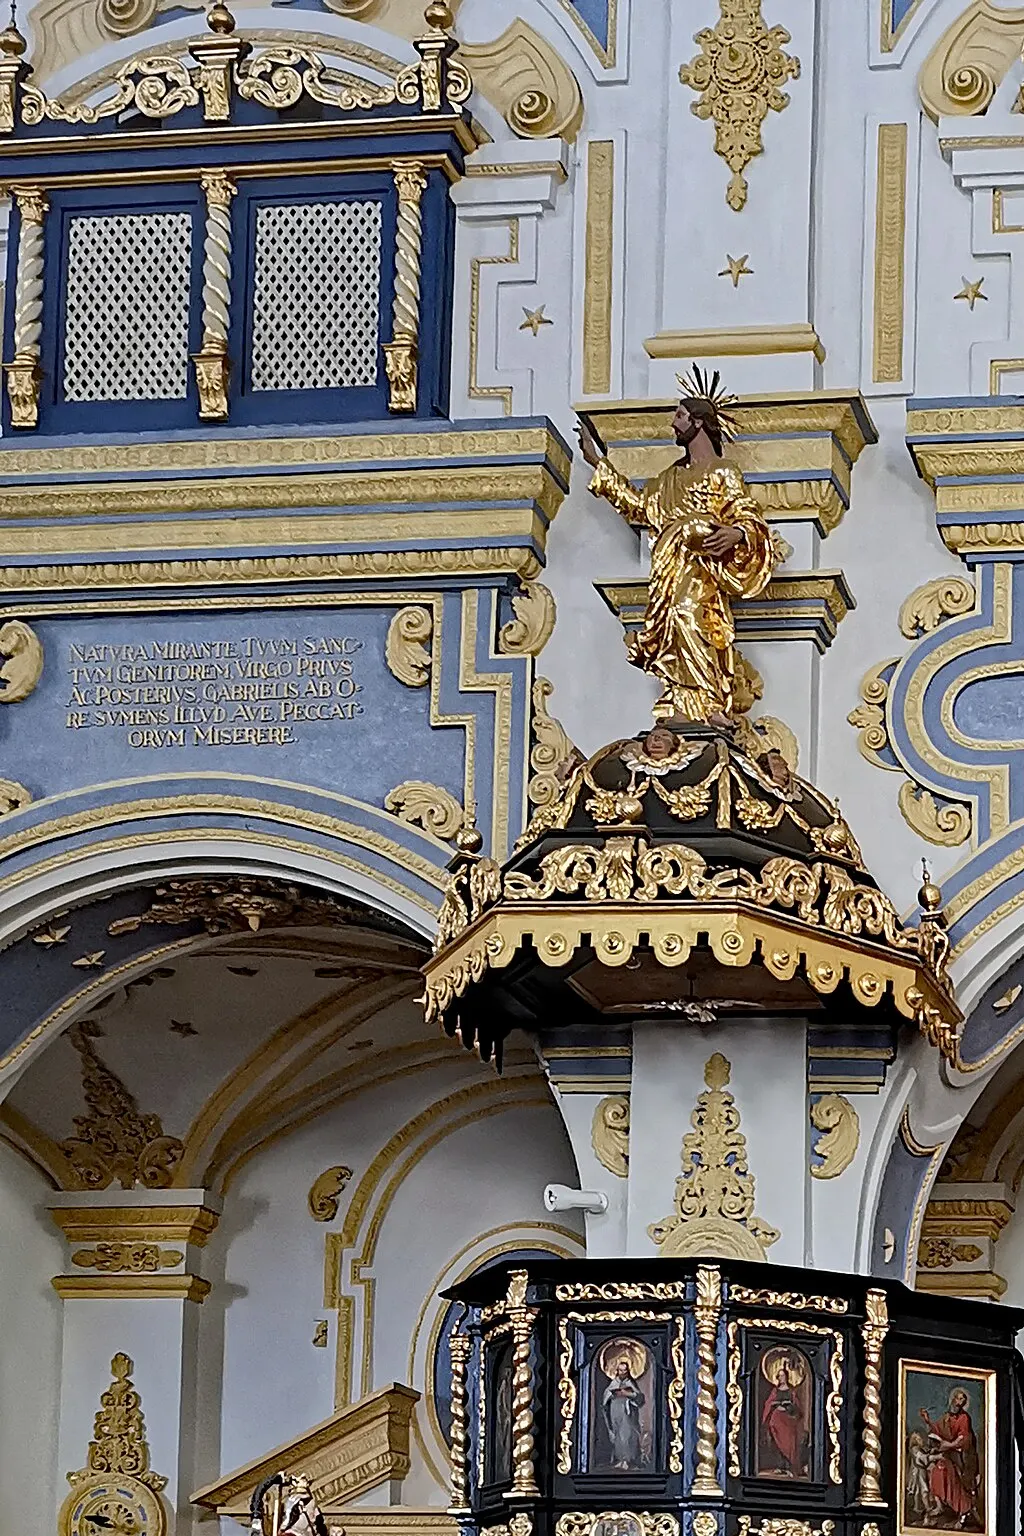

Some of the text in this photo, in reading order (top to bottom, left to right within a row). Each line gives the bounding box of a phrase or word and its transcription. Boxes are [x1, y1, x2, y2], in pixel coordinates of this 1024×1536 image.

[68, 665, 113, 685] TVM
[234, 659, 293, 680] VIRGO
[296, 656, 354, 678] PRIVS
[202, 680, 300, 704] GABRIELIS
[301, 678, 333, 699] AB
[66, 711, 92, 729] RE
[173, 704, 227, 725] ILLVD
[128, 728, 187, 749] ORVM
